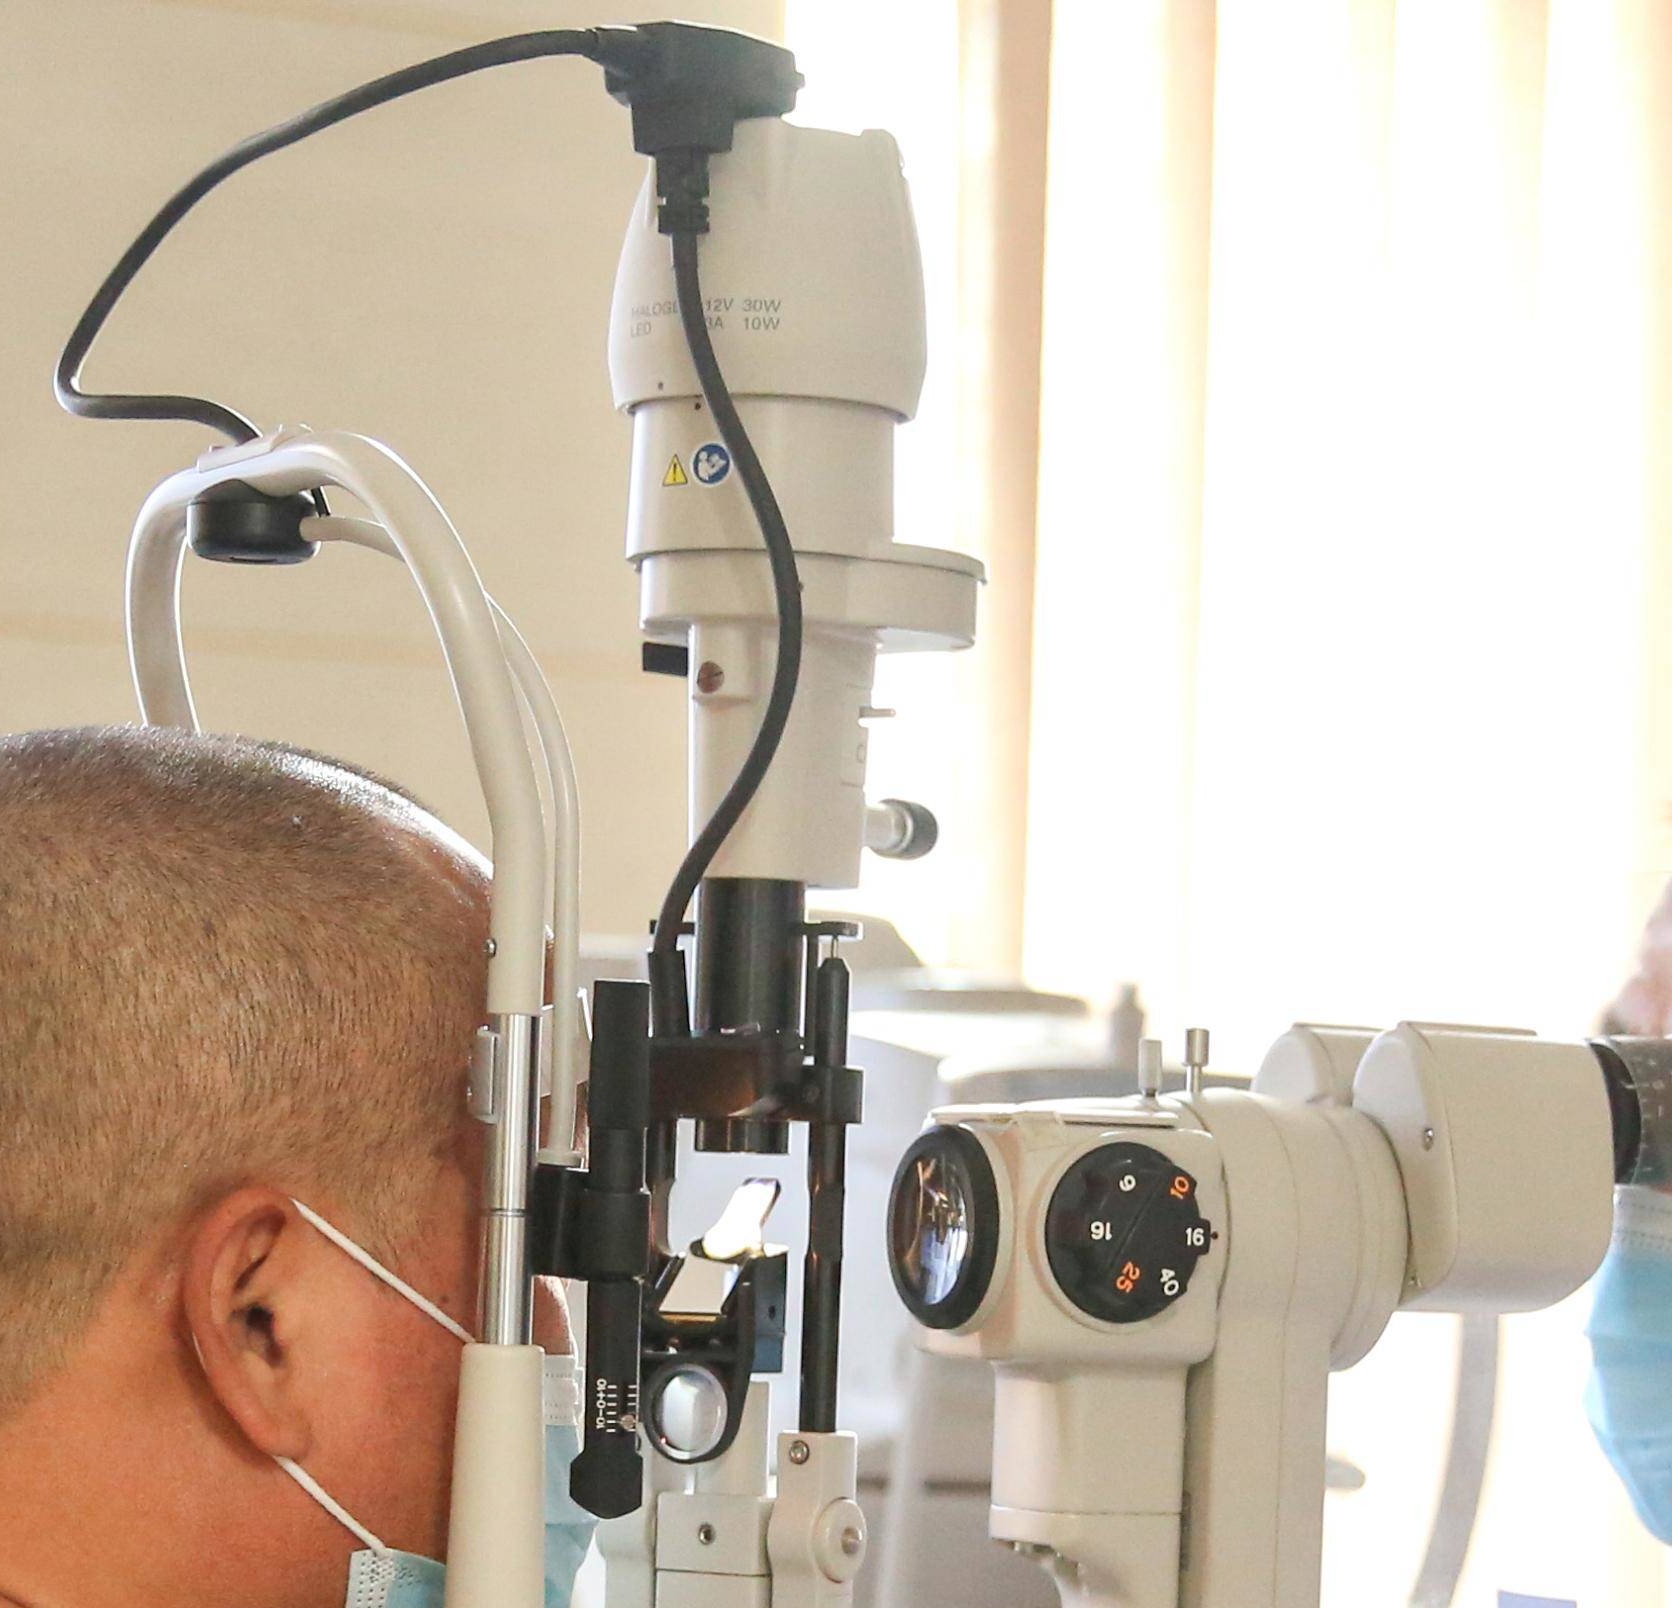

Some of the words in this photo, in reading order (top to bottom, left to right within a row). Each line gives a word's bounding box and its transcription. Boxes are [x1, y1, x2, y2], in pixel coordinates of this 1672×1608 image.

[743, 298, 781, 313] 30W
[630, 322, 652, 338] LED
[743, 317, 781, 331] 10W
[1170, 1175, 1190, 1199] 10
[1185, 1227, 1205, 1246] 16
[1116, 1261, 1141, 1293] 25
[1159, 1267, 1179, 1296] 40
